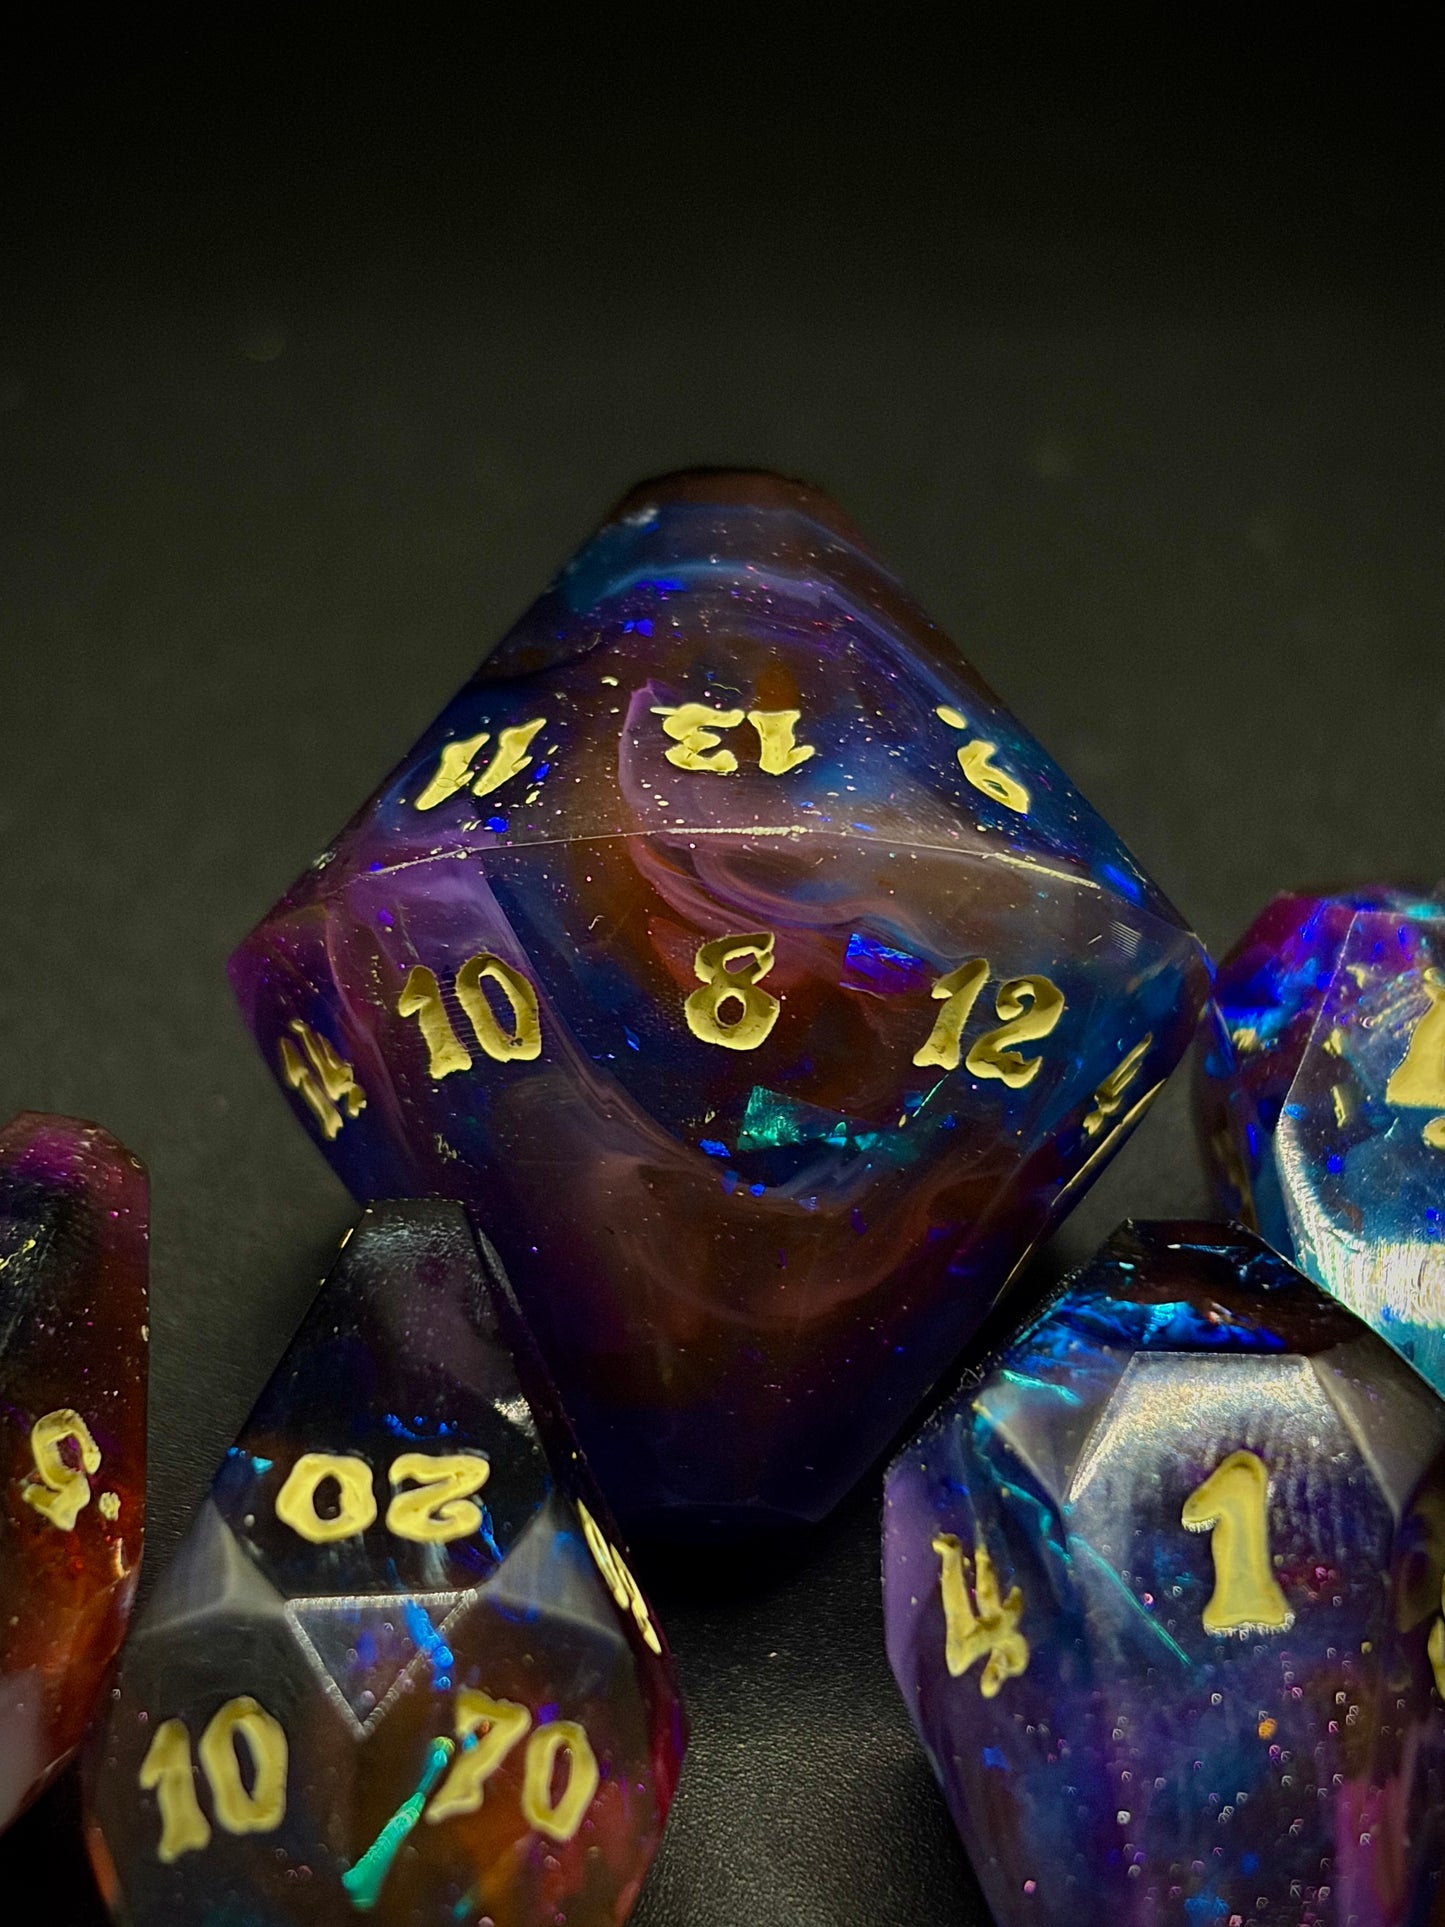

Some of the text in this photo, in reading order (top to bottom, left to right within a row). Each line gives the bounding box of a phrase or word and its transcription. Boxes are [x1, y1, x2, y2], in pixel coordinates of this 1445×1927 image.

[649, 703, 815, 776] 13
[398, 952, 542, 1080] 10
[684, 932, 781, 1051] 8
[912, 958, 1066, 1090] 12
[275, 1453, 491, 1544] 20
[1181, 1450, 1296, 1638] 1
[139, 1695, 289, 1864] 10
[425, 1687, 599, 1842] 70
